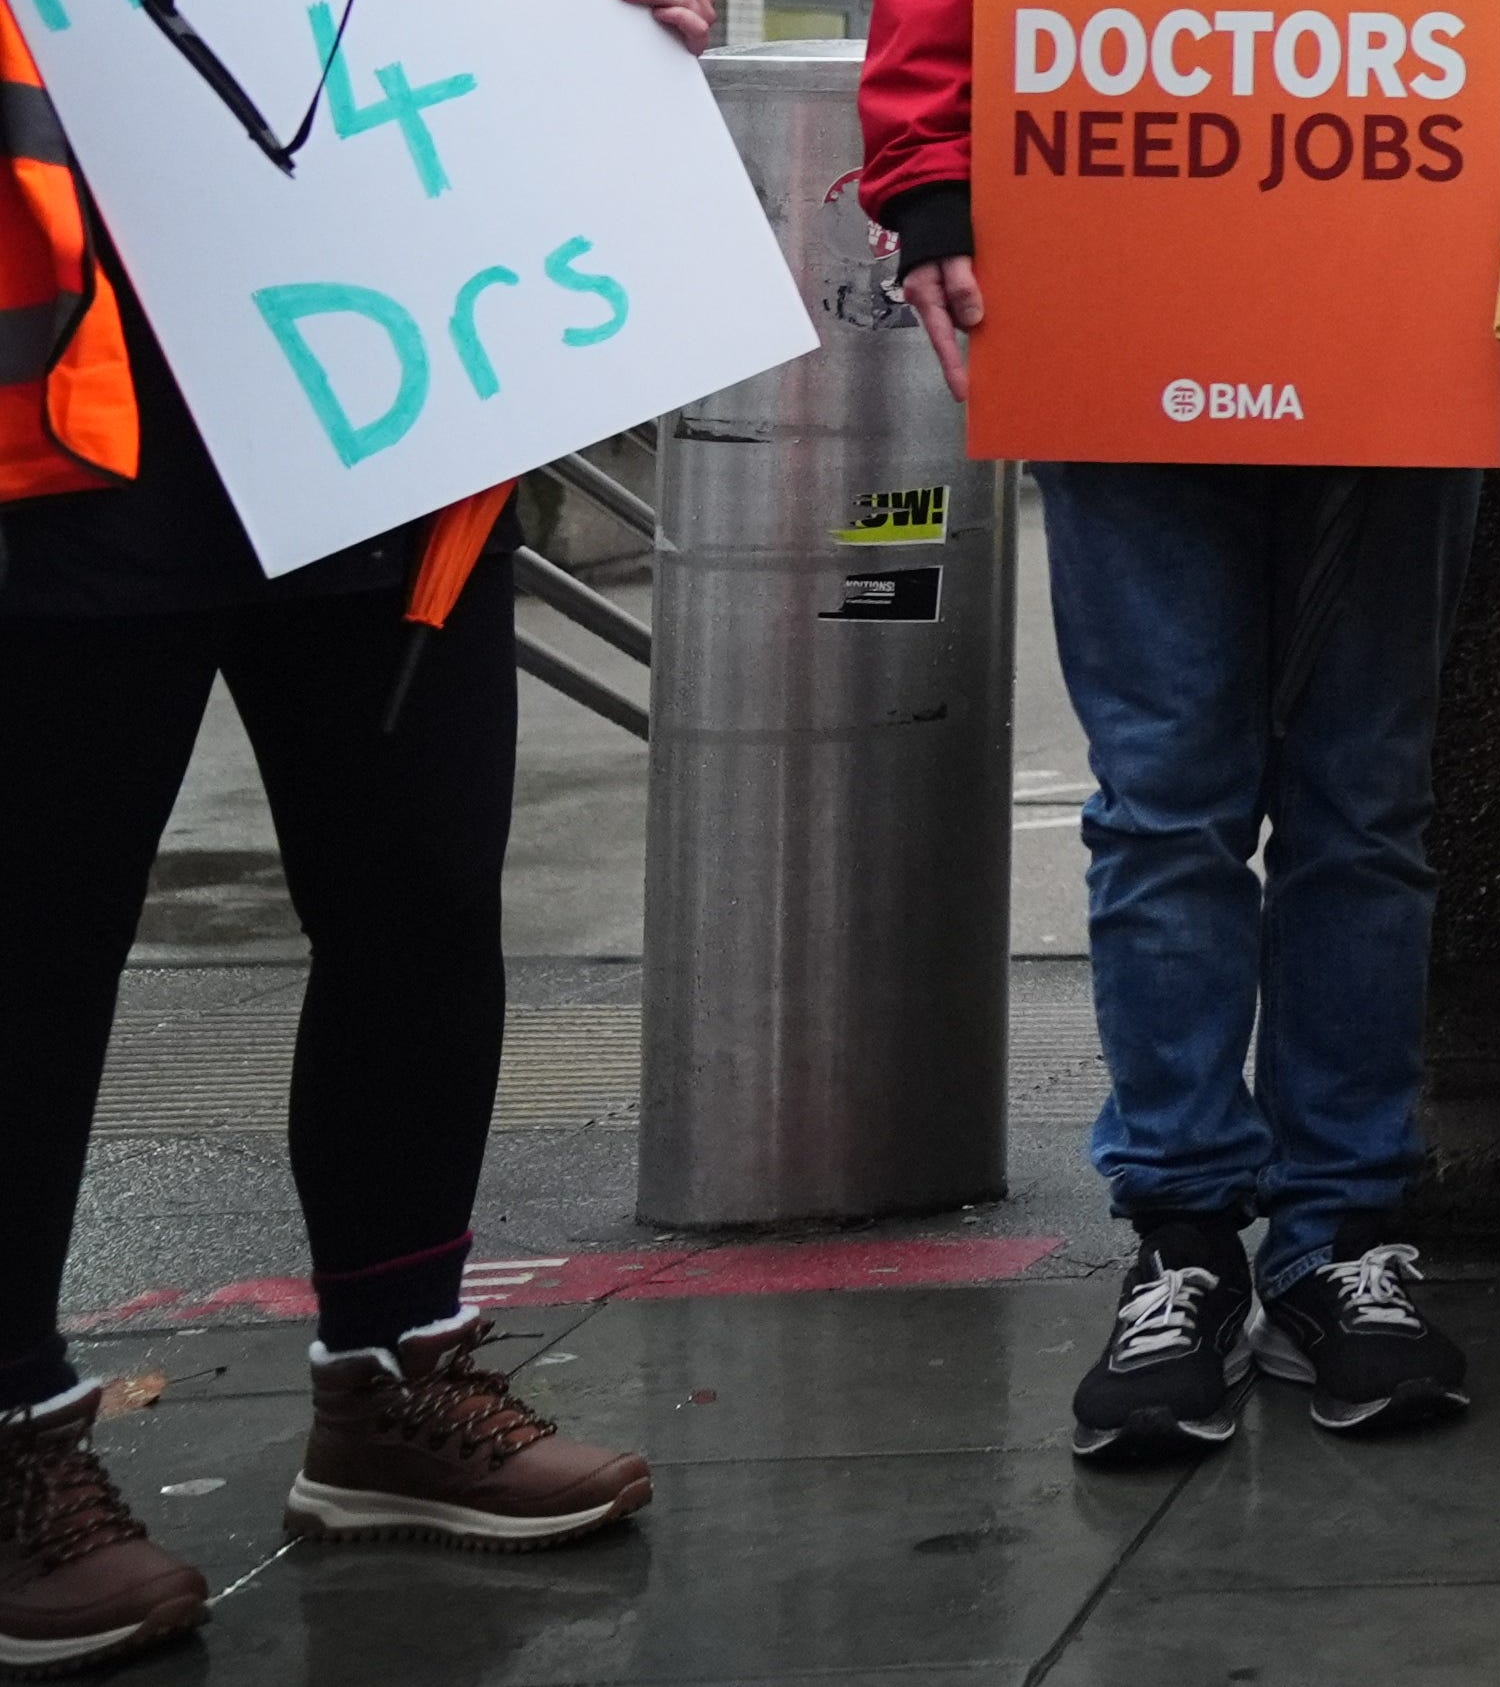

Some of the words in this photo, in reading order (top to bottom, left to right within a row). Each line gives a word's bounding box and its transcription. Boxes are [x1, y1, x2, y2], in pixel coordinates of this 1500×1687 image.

[1015, 8, 1467, 99] DOCTORS
[307, 1, 477, 199] 4
[1014, 111, 1240, 178] NEED
[1259, 113, 1465, 193] JOBS
[251, 235, 629, 470] Drs
[1209, 383, 1304, 420] BMA
